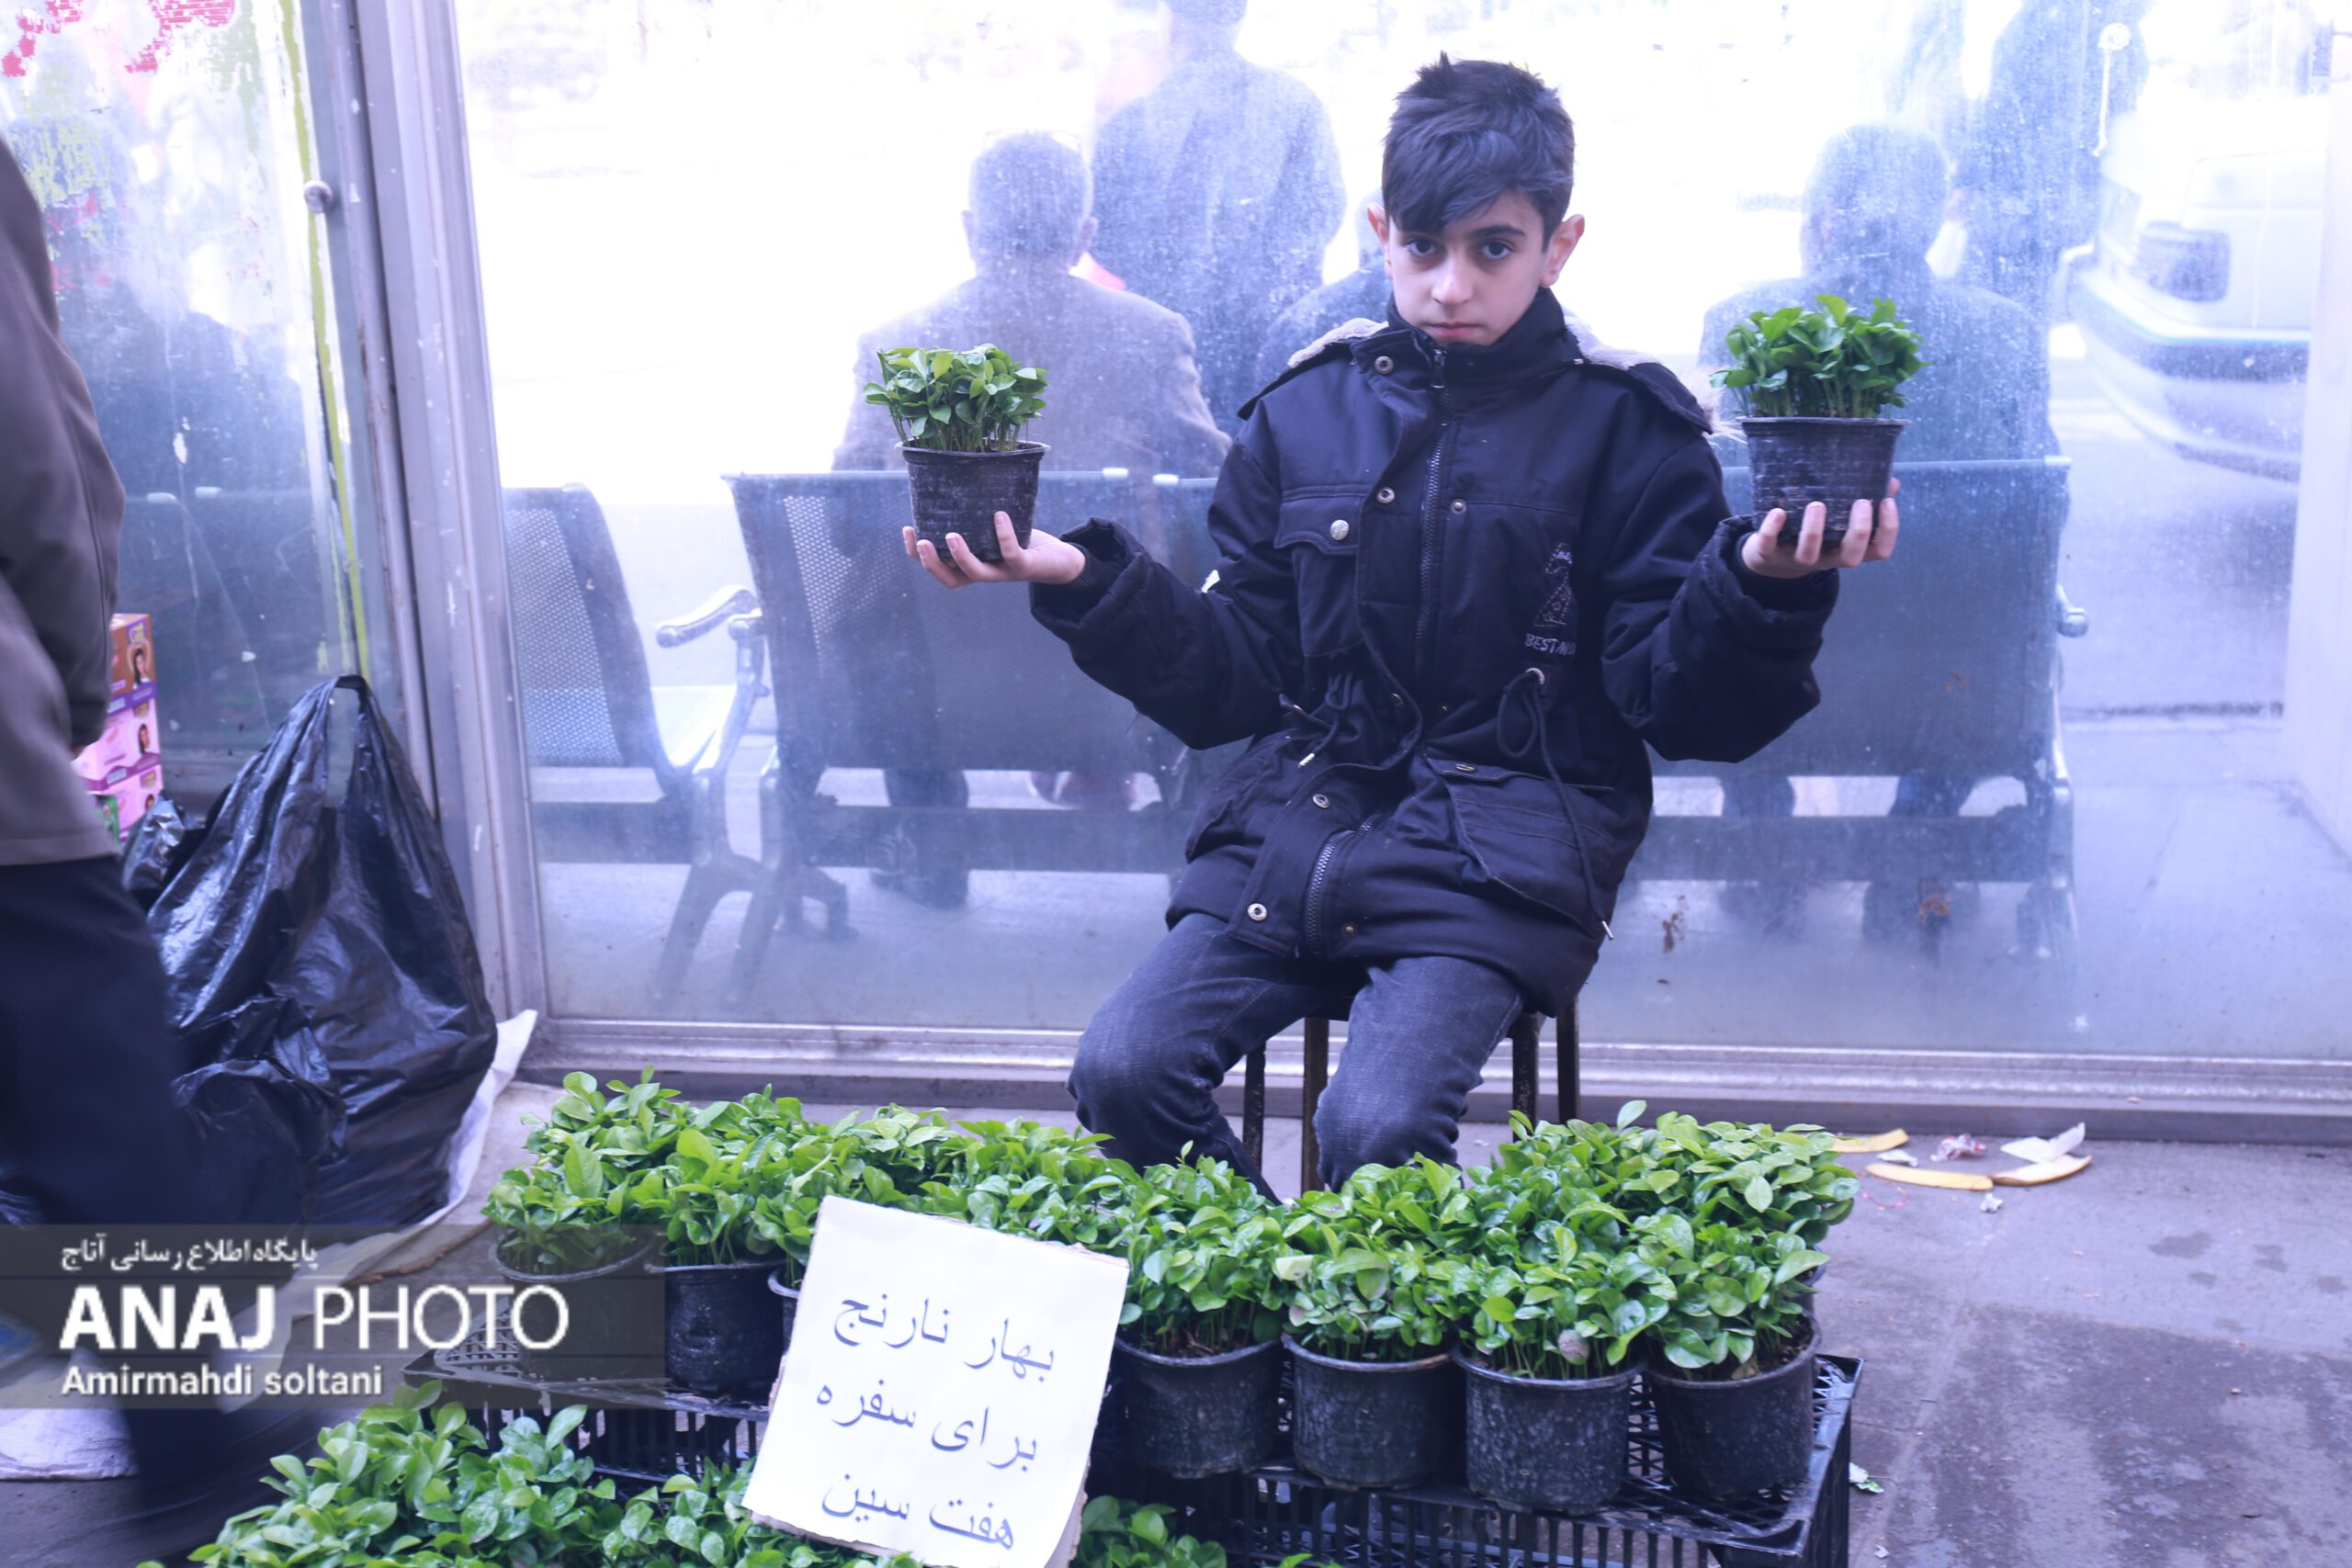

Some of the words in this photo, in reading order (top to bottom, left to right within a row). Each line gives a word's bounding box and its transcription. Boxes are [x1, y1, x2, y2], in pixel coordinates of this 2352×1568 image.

[833, 1293, 950, 1348] نارنج
[963, 1318, 1055, 1382] بهار
[816, 1379, 917, 1428] سفره
[931, 1405, 1037, 1472] برای
[821, 1472, 910, 1523] سین
[929, 1499, 1014, 1551] هفت
